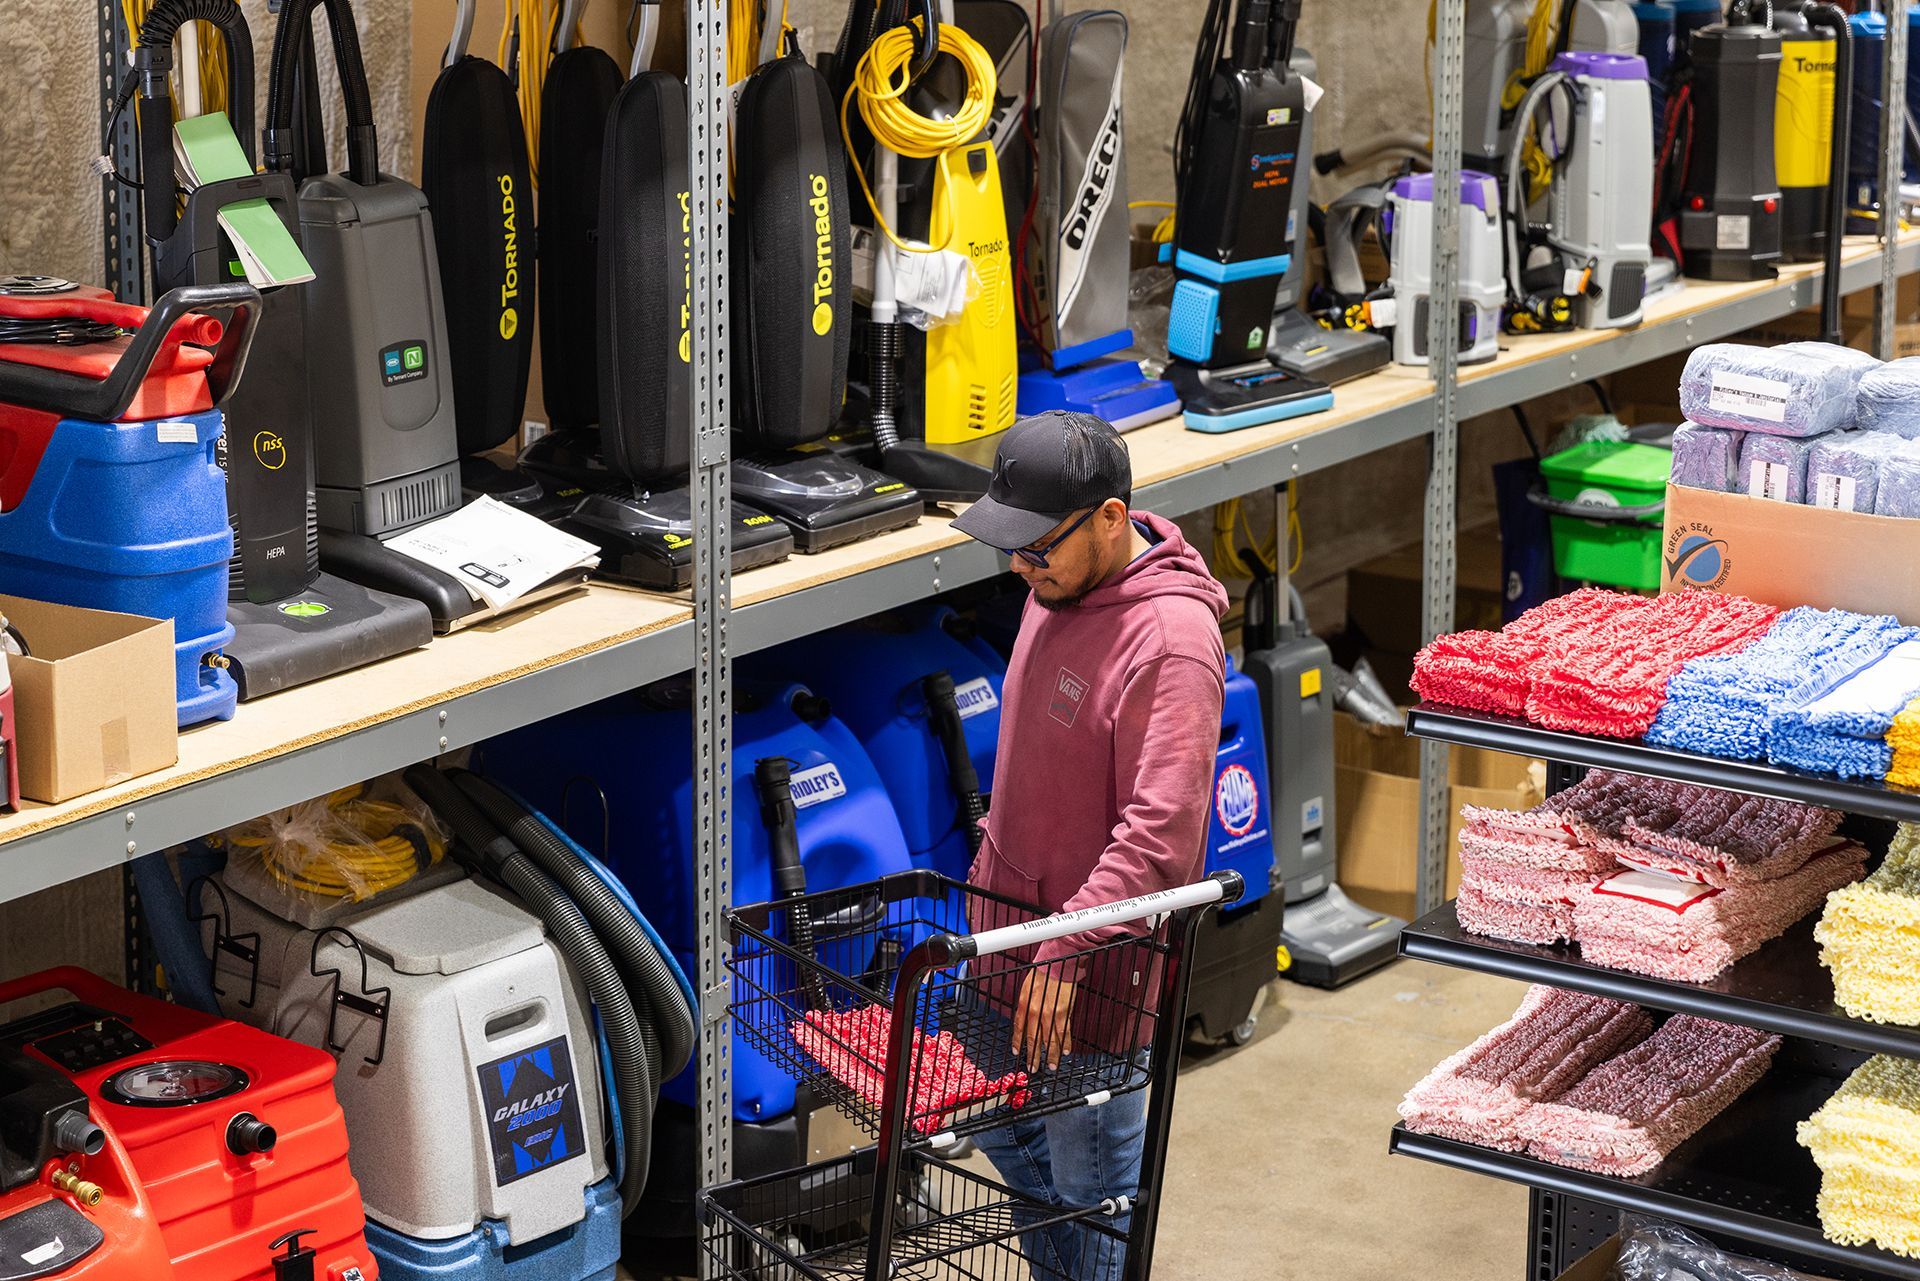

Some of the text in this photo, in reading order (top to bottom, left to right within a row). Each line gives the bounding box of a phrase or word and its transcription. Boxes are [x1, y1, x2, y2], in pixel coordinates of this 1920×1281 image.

[501, 174, 518, 308] TORNADO
[809, 175, 833, 306] Tornado
[968, 238, 1003, 258] Tornado
[262, 437, 283, 452] nss
[218, 457, 227, 467] 15
[1668, 522, 1713, 554] GREEN SEAL
[266, 546, 286, 560] HEPA
[1714, 558, 1731, 588] CERTIFIED
[1058, 674, 1083, 702] VANS
[790, 771, 839, 799] RIDLEY'S
[494, 1083, 569, 1122] GALAXY
[507, 1099, 562, 1132] 2000
